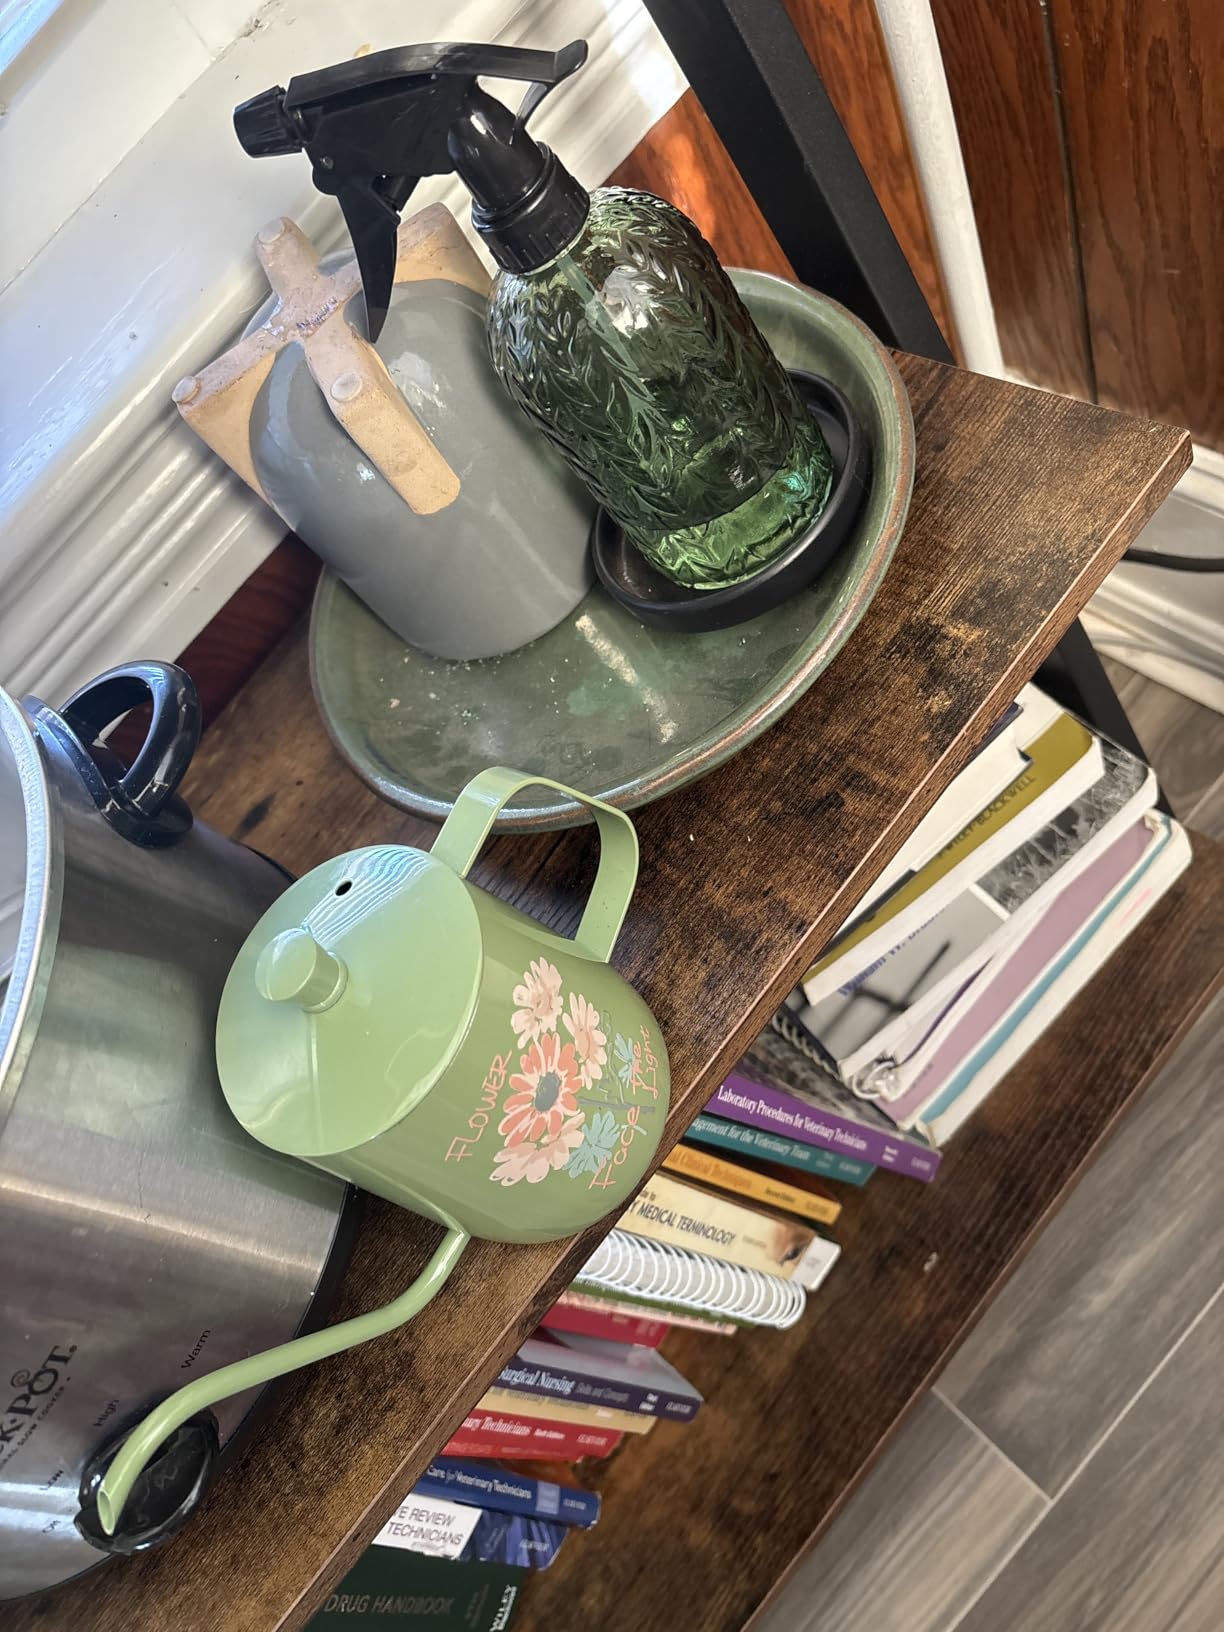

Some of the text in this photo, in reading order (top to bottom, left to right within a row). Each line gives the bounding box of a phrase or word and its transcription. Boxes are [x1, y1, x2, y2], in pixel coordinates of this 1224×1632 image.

[444, 1050, 513, 1162] FLOWER
[717, 1085, 758, 1114] Laboratory
[756, 1100, 794, 1127] Procedures
[793, 1110, 804, 1128] for
[802, 1115, 836, 1143] Veterinary
[588, 1105, 641, 1190] Face
[727, 1122, 741, 1142] for
[739, 1127, 755, 1144] the
[753, 1131, 794, 1157] Veterinary
[637, 1202, 676, 1228] MEDICAL
[676, 1214, 737, 1246] TERMINOLOGY
[181, 1329, 212, 1370] Warm
[538, 1370, 576, 1395] Nursing
[94, 1399, 120, 1428] High
[480, 1415, 532, 1438] Technicians
[427, 1466, 446, 1480] Care
[455, 1469, 494, 1492] Veterinary
[410, 1507, 455, 1527] REVIEW
[386, 1522, 464, 1546] TECHNICIANS
[323, 1594, 370, 1614] DRUG
